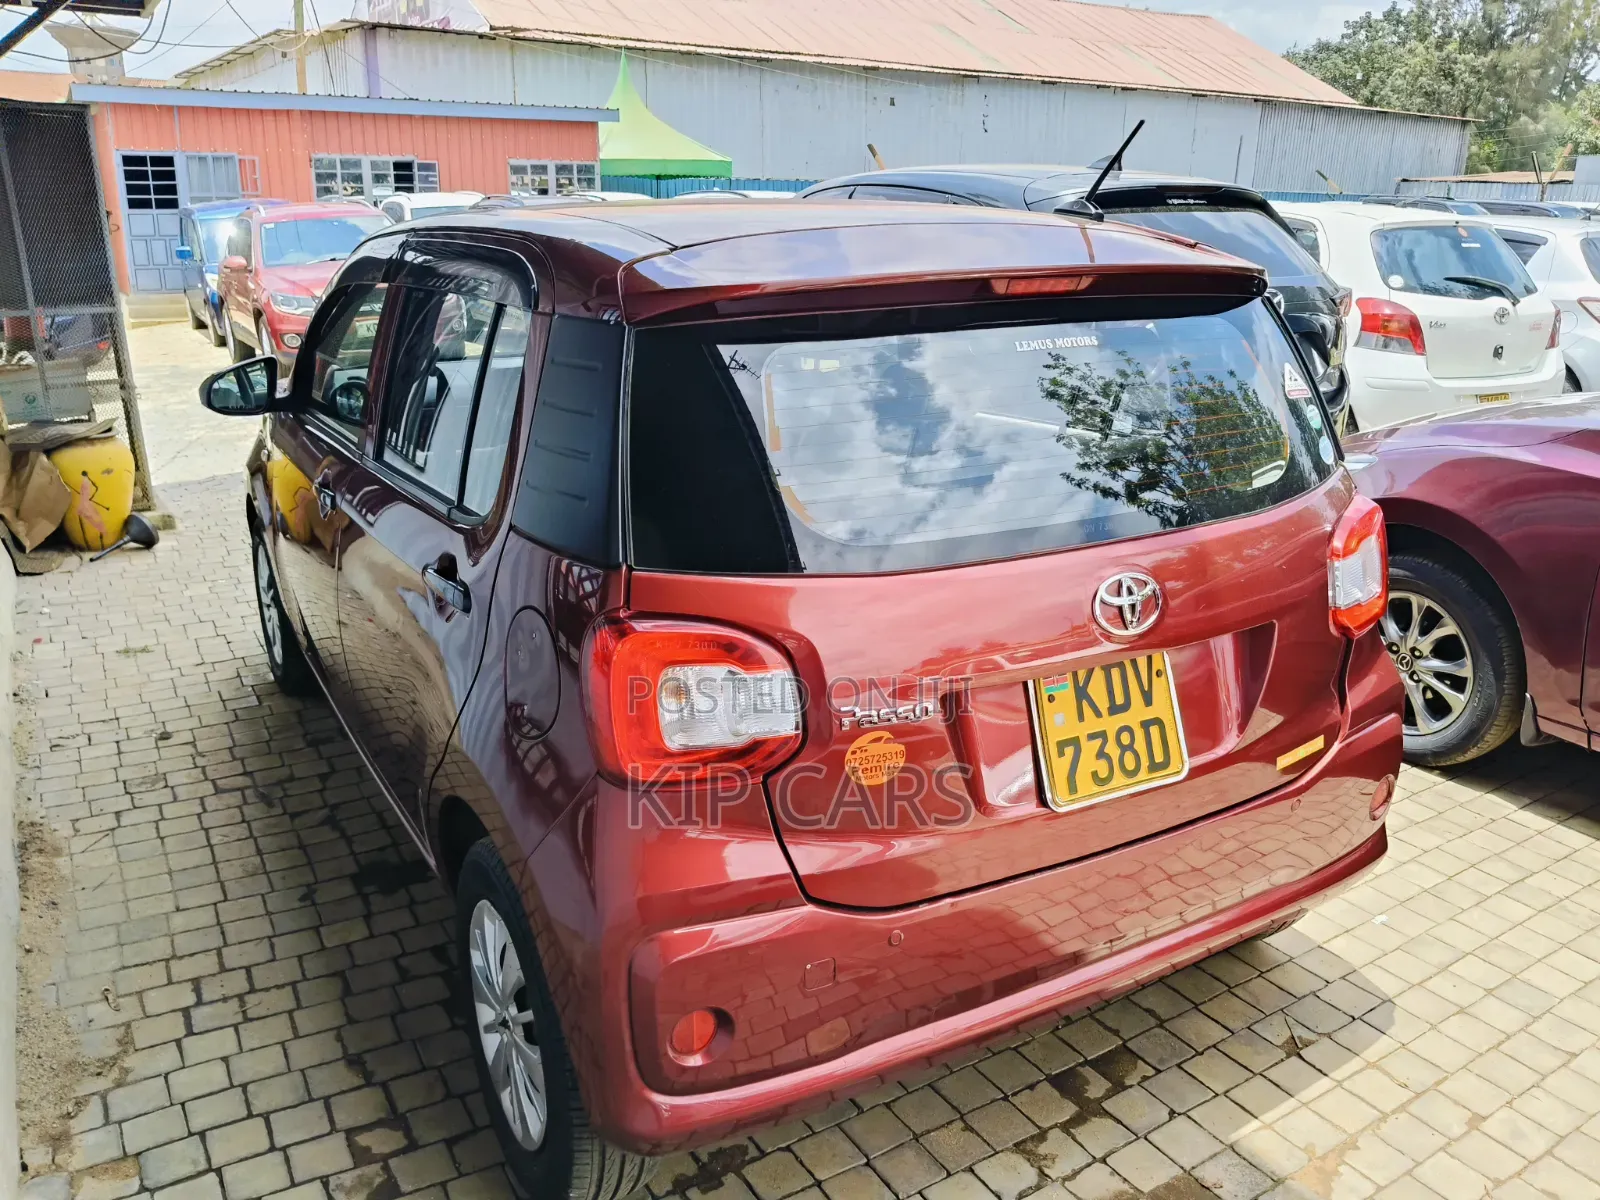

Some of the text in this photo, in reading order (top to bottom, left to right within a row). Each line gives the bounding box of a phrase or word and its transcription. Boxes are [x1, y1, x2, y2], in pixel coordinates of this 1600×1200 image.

[1014, 335, 1099, 352] LEMUS MOTORS
[1071, 654, 1154, 723] KDV
[846, 749, 905, 767] 0725725319
[1055, 716, 1172, 796] 738D
